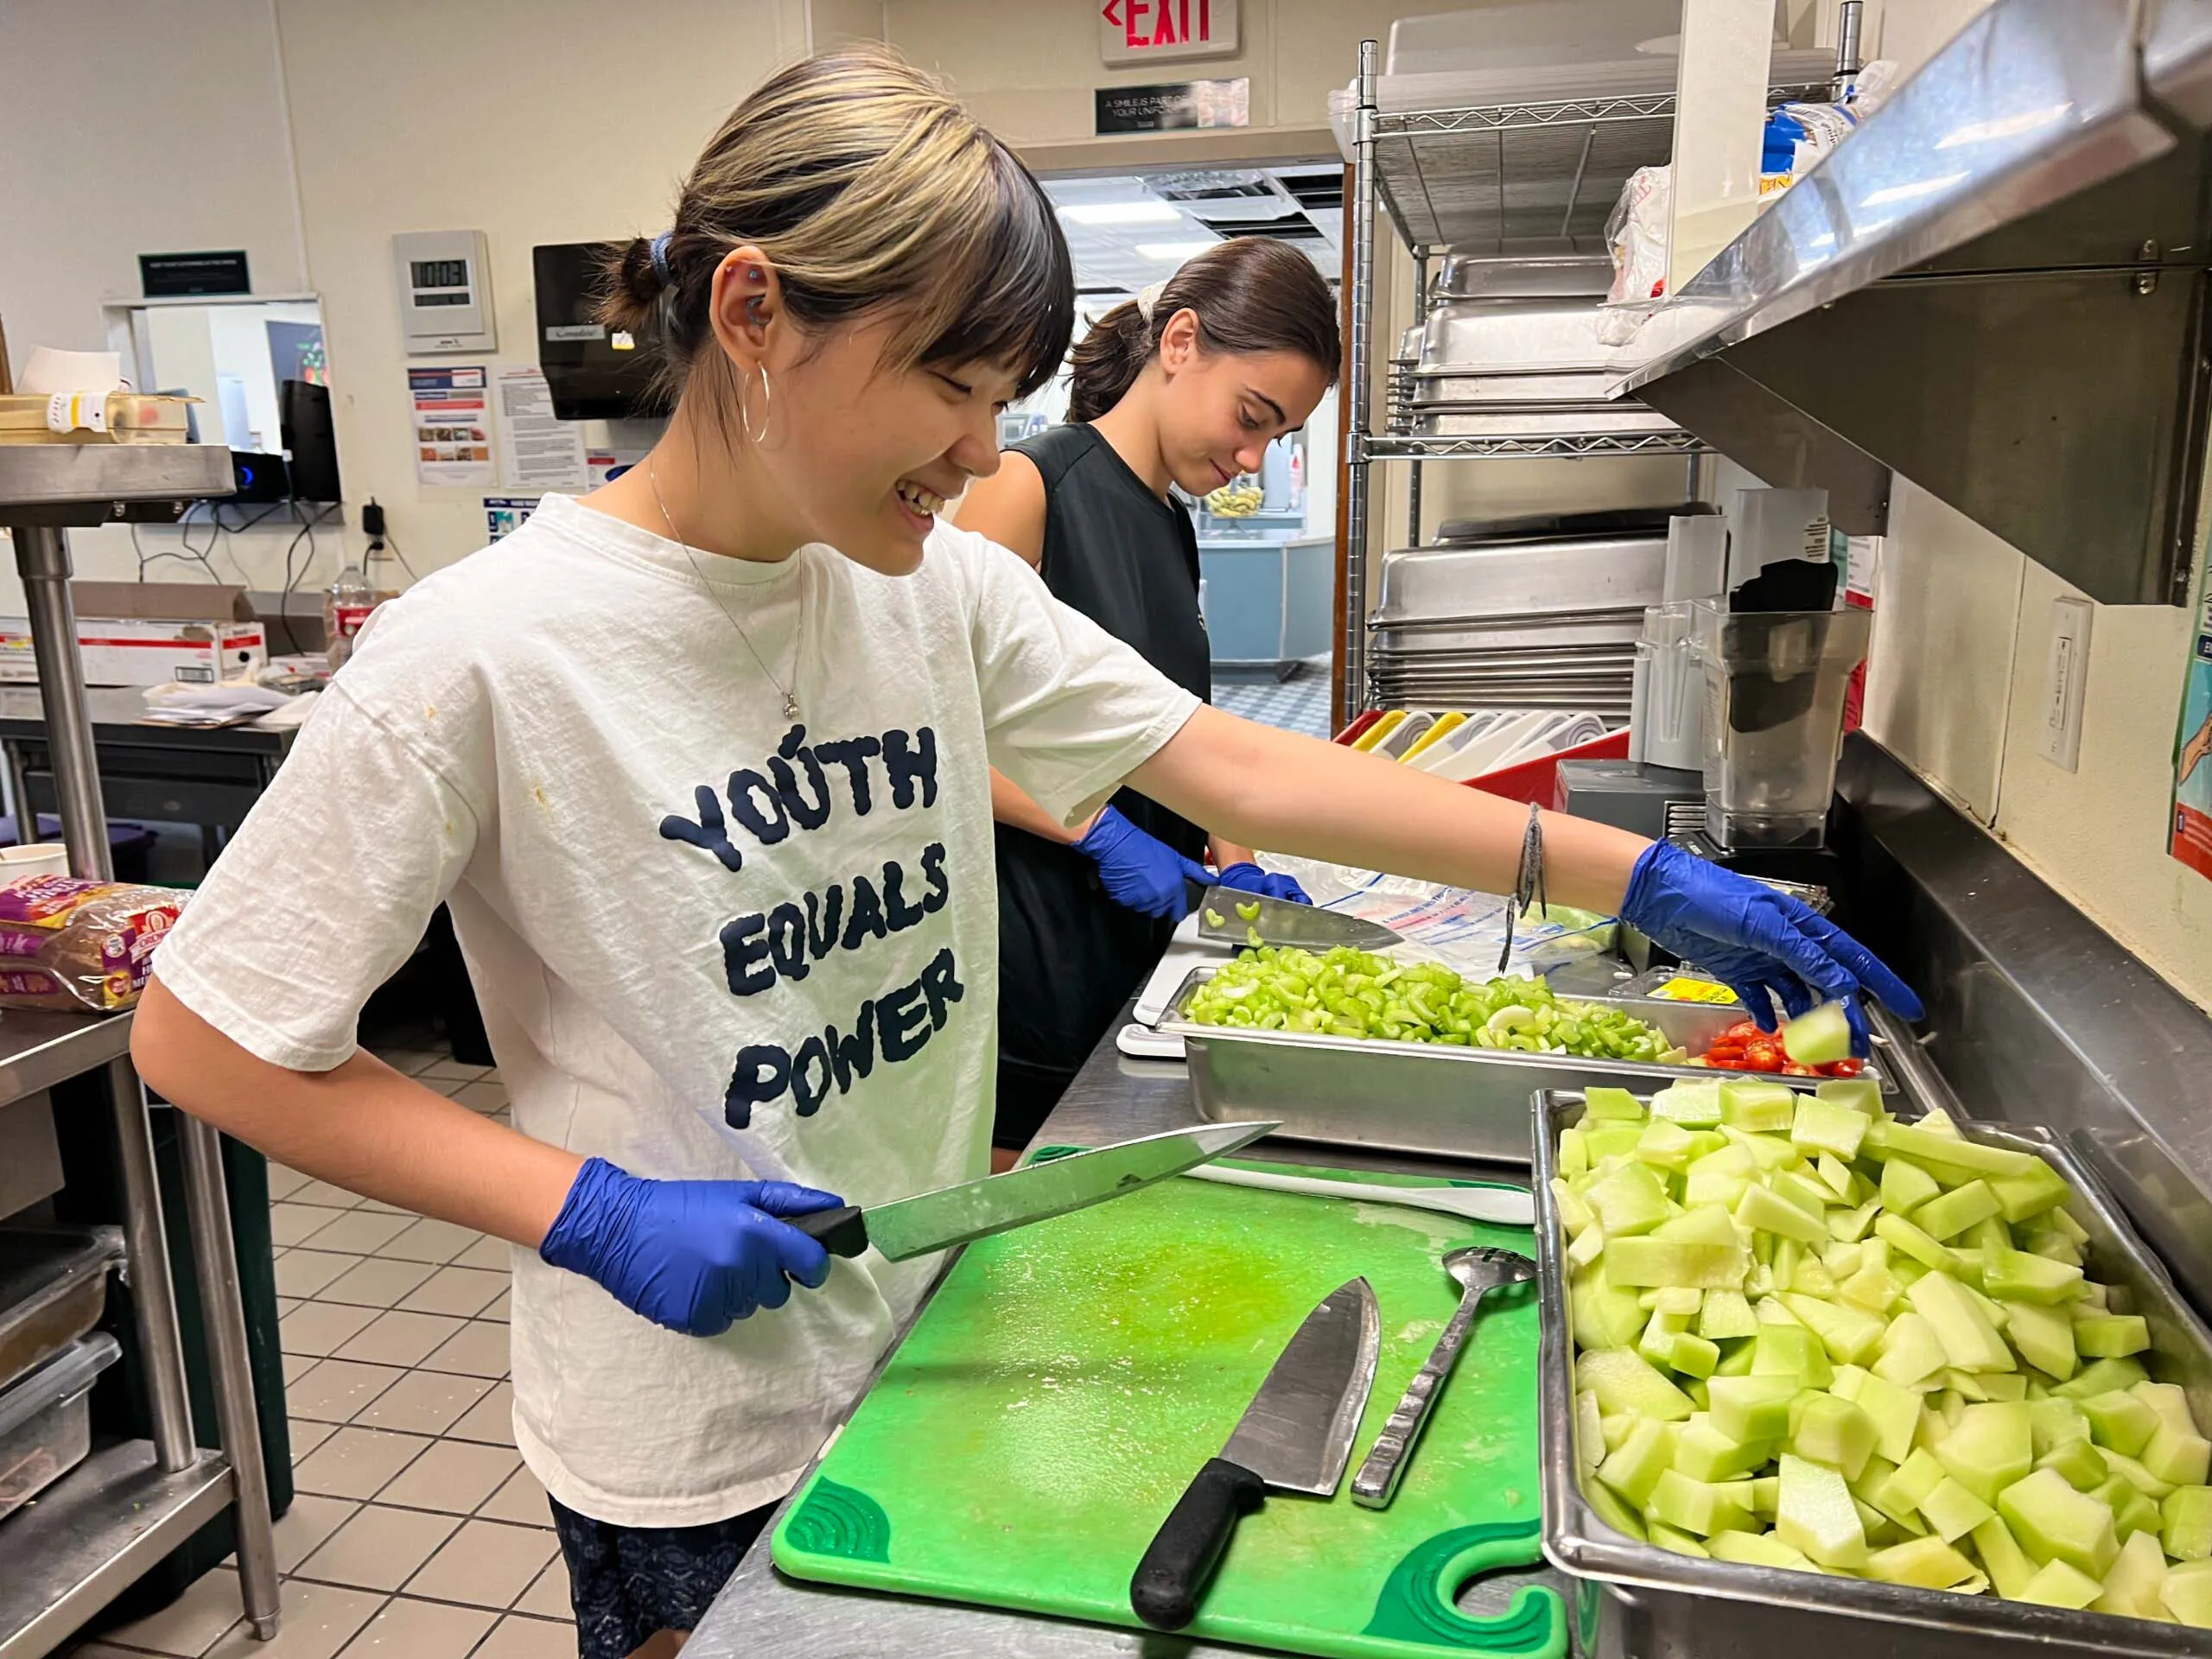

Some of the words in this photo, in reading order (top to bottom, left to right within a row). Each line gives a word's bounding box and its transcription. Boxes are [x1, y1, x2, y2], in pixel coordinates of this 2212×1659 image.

[1112, 106, 1137, 118] YOUR
[1113, 97, 1139, 108] SMILE
[1140, 97, 1148, 106] IS
[720, 842, 948, 996] EQUALS
[725, 948, 963, 1129] POWER
